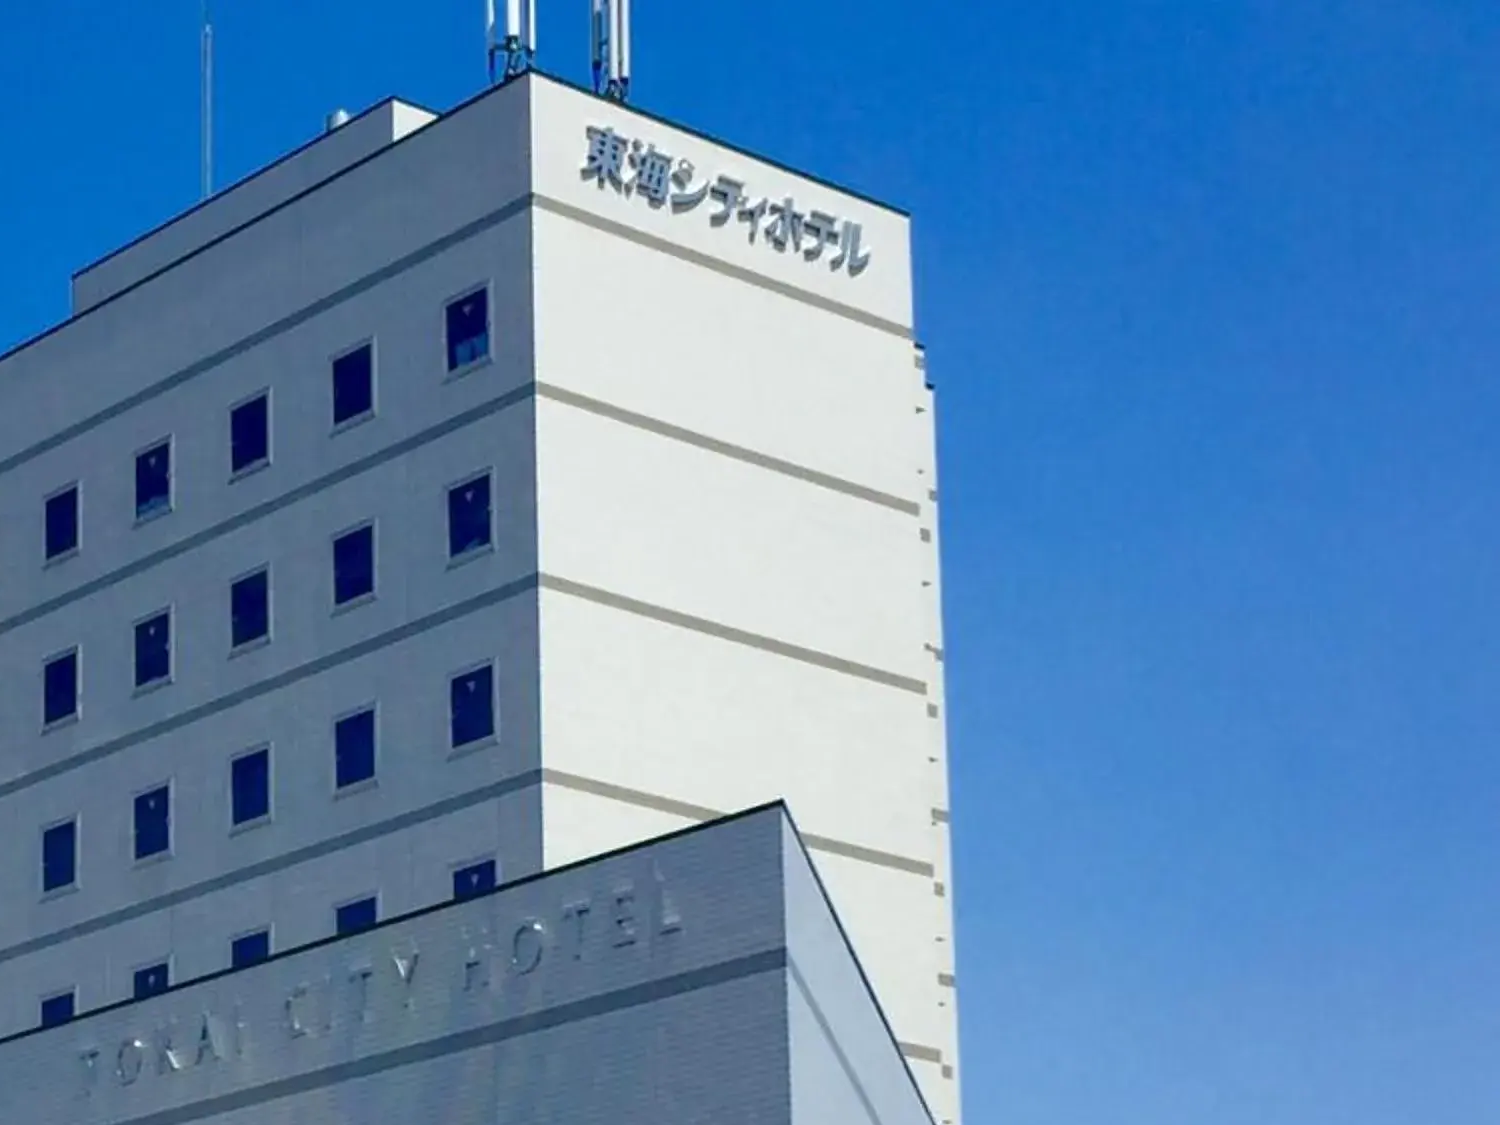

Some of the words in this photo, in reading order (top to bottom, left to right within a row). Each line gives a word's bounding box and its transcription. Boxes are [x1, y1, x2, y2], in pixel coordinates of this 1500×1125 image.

[579, 124, 871, 278] 東海シティホテル
[78, 1000, 246, 1097] TOKAI
[284, 944, 420, 1040] CITY
[458, 856, 684, 994] HOTEL
